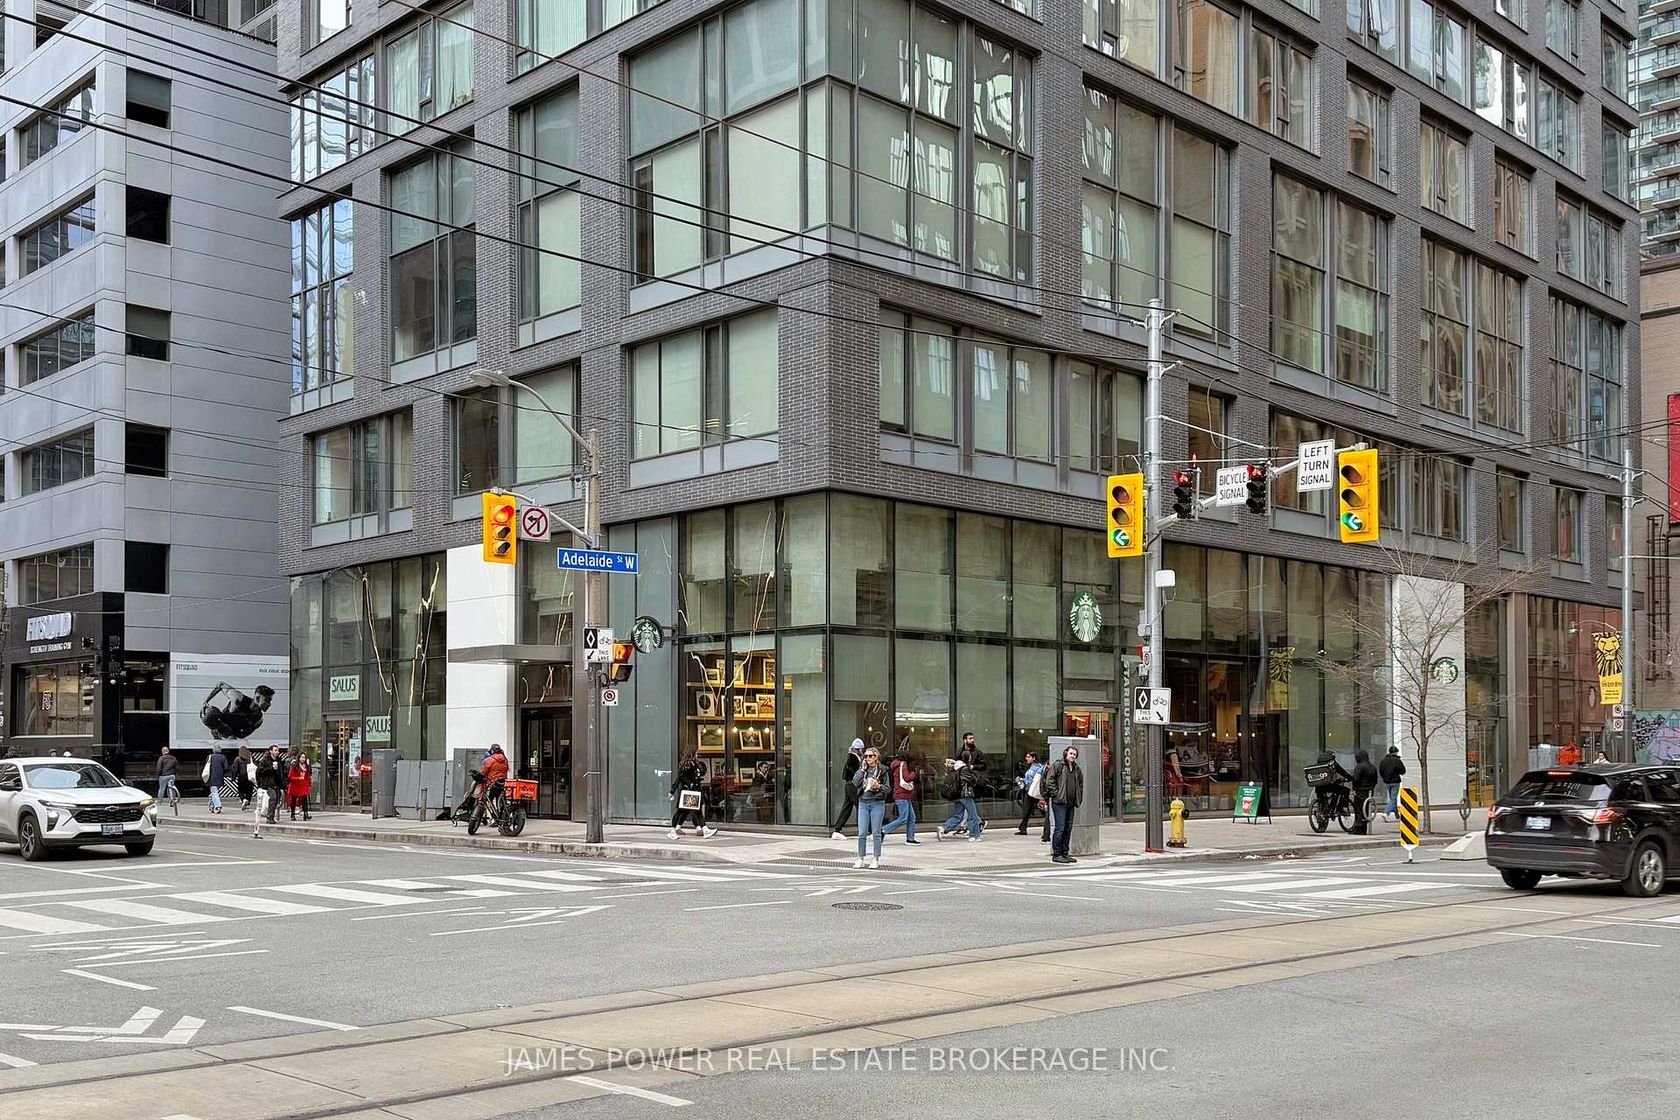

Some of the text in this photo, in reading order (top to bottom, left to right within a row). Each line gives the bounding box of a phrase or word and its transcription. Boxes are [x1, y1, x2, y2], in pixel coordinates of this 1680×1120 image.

[1304, 446, 1329, 458] LEFT
[1304, 460, 1329, 471] TURN
[1219, 472, 1247, 486] BICYCLE
[1300, 473, 1330, 486] SIGNAL
[1219, 487, 1245, 500] SIGNAL
[562, 551, 634, 569] Adelaide St W
[331, 677, 356, 692] SALUS
[1123, 660, 1131, 745] STARBUCKS
[366, 718, 391, 733] SALUS
